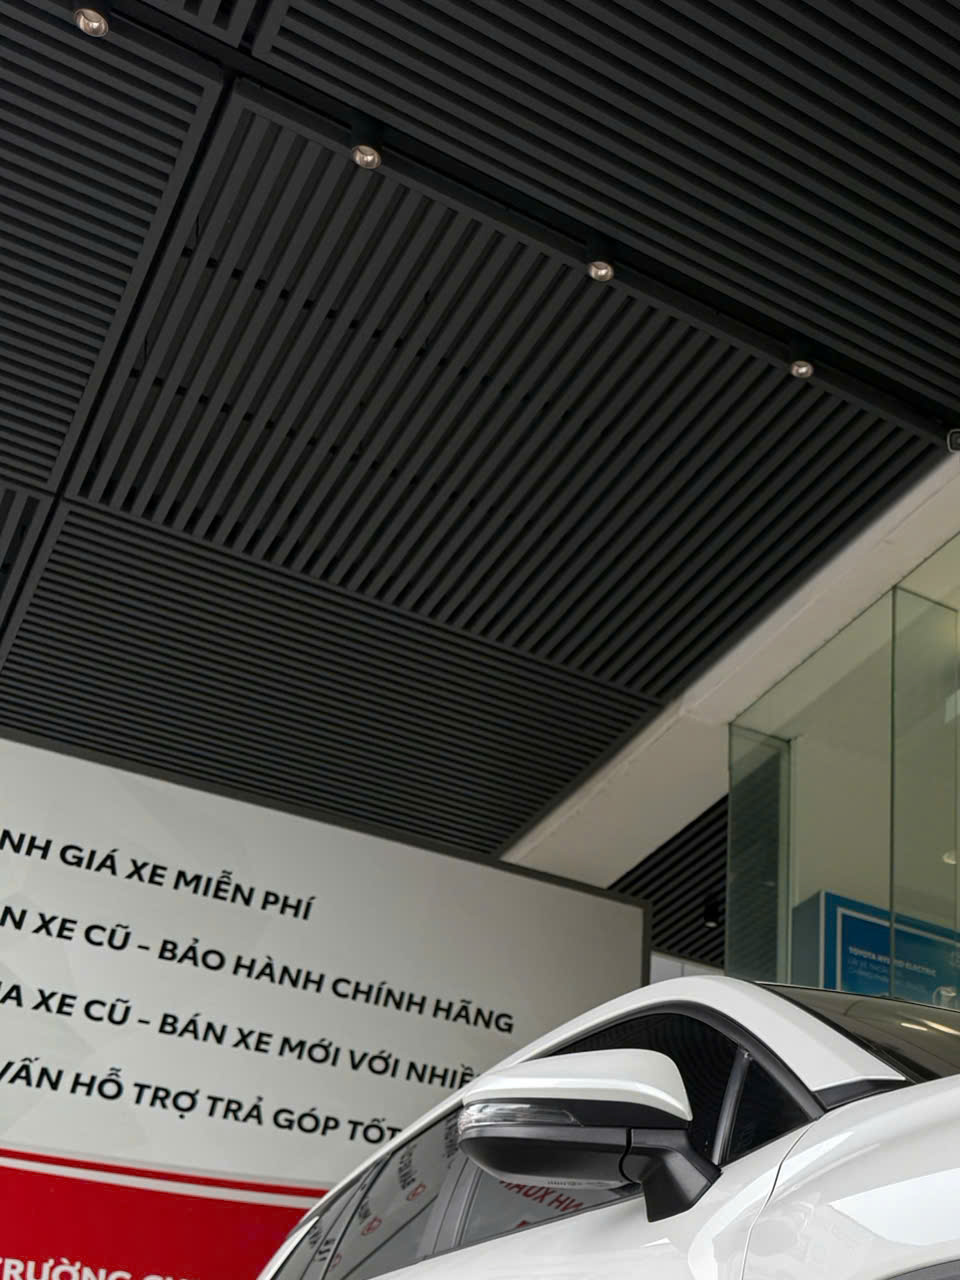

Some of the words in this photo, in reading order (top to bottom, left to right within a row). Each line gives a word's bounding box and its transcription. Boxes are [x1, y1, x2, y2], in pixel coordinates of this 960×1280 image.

[59, 844, 119, 876] GIÁ
[125, 858, 168, 886] XE
[173, 870, 255, 907] MIỄN
[261, 890, 316, 921] PHÍ
[32, 912, 78, 941] XE
[84, 924, 131, 950] CŨ
[158, 938, 226, 972] BẢO
[232, 955, 325, 993] HÀNH
[331, 978, 427, 1016] CHÍNH
[432, 998, 514, 1034] HÃNG
[0, 981, 23, 1008] A
[32, 988, 78, 1016] XE
[84, 998, 131, 1026] CŨ
[158, 1013, 227, 1045] BÁN
[232, 1027, 273, 1053] XE
[278, 1037, 341, 1067] MỚI
[349, 1049, 400, 1078] VỚI
[406, 1061, 481, 1090] NHIỀ
[70, 1066, 124, 1100] HỖ
[133, 1083, 200, 1119] TRỢ
[207, 1095, 263, 1126] TRẢ
[273, 1107, 340, 1137] GÓP
